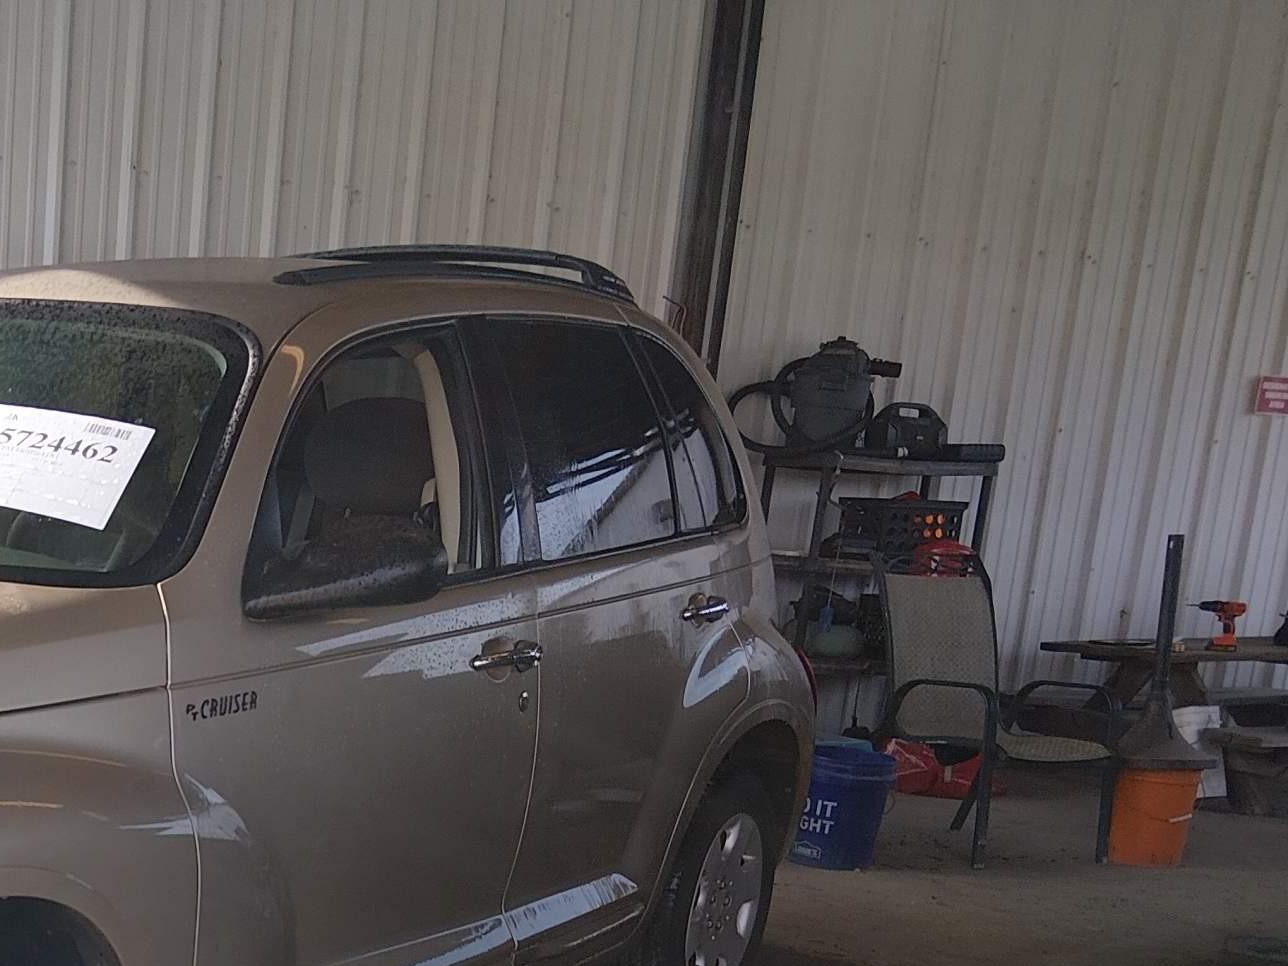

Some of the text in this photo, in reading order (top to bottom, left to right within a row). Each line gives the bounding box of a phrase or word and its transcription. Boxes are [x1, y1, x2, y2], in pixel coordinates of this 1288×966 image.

[186, 690, 258, 721] PT CRUISER
[815, 799, 838, 818] IT
[799, 816, 835, 835] GHT
